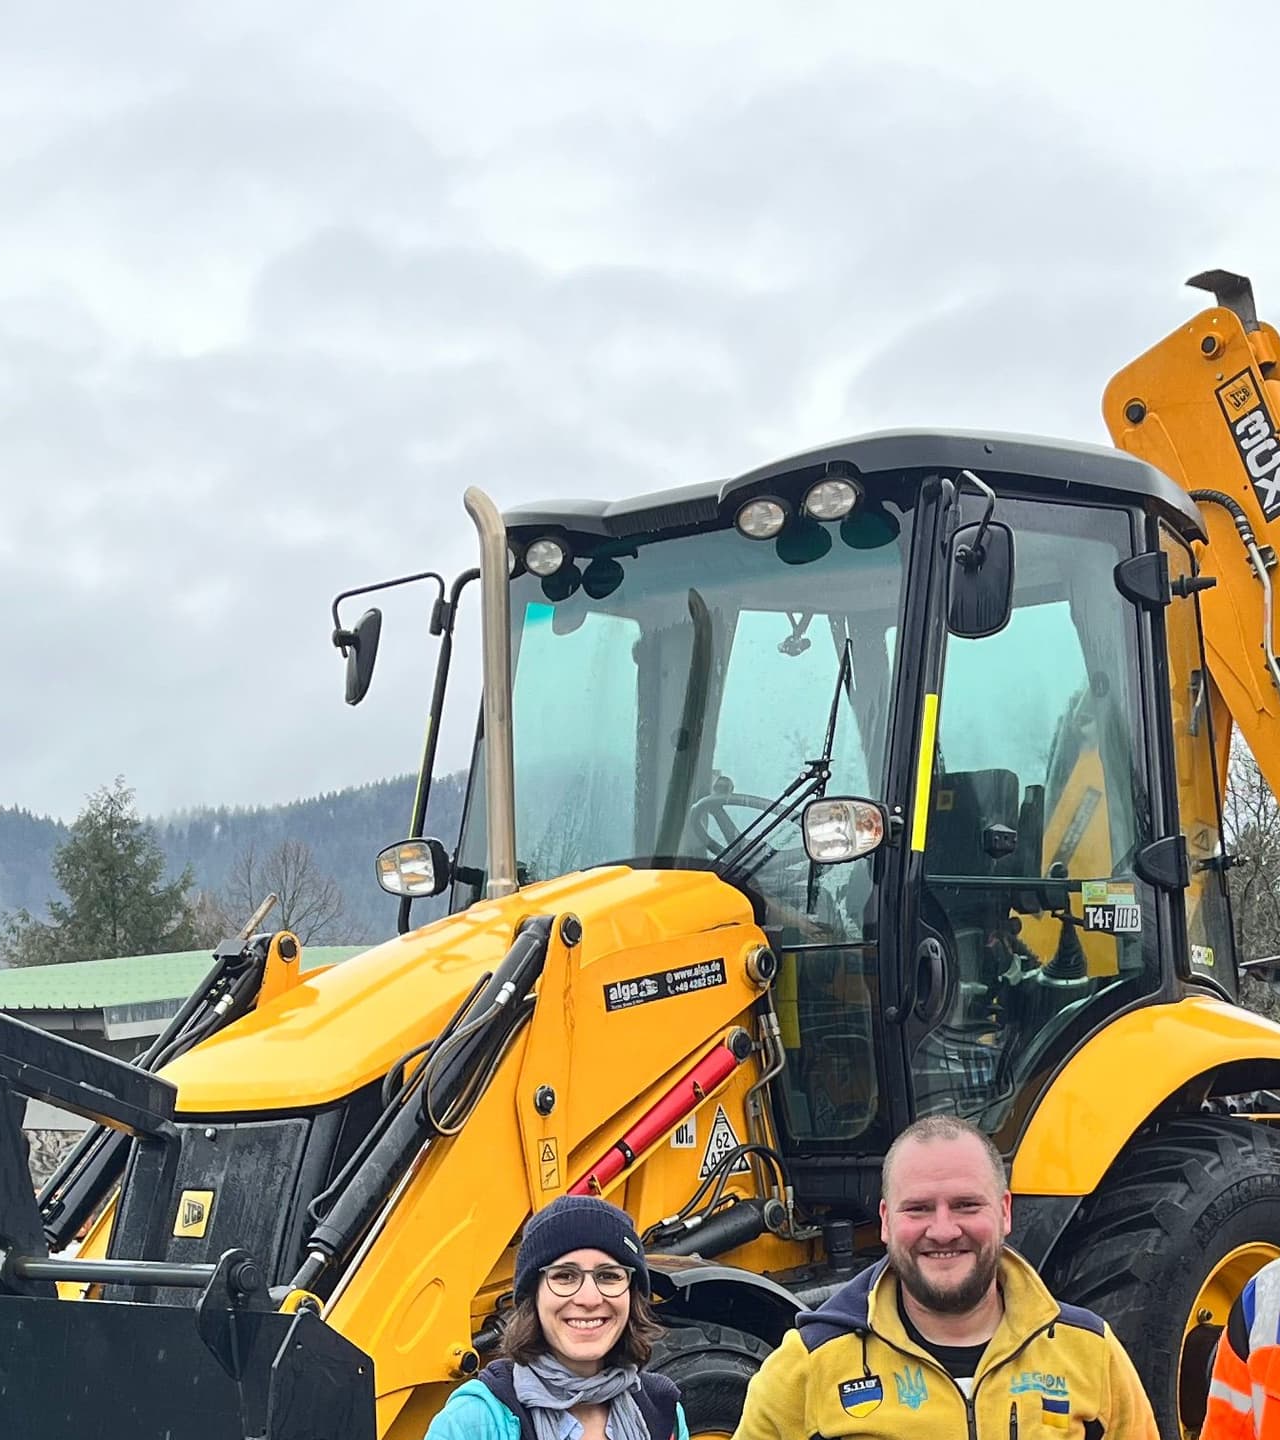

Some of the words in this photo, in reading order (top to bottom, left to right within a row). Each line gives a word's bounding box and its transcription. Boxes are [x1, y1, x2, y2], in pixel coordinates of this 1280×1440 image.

[1229, 386, 1251, 408] JCB
[1085, 907, 1114, 929] T4F
[673, 961, 721, 981] www.alga.de
[609, 982, 639, 1001] alga
[675, 980, 689, 992] +49
[689, 977, 707, 989] 4282
[707, 973, 723, 986] 57-0
[715, 1132, 730, 1149] 62
[184, 1202, 203, 1225] JCB
[842, 1380, 867, 1393] 5.11
[1011, 1372, 1066, 1390] LEGION
